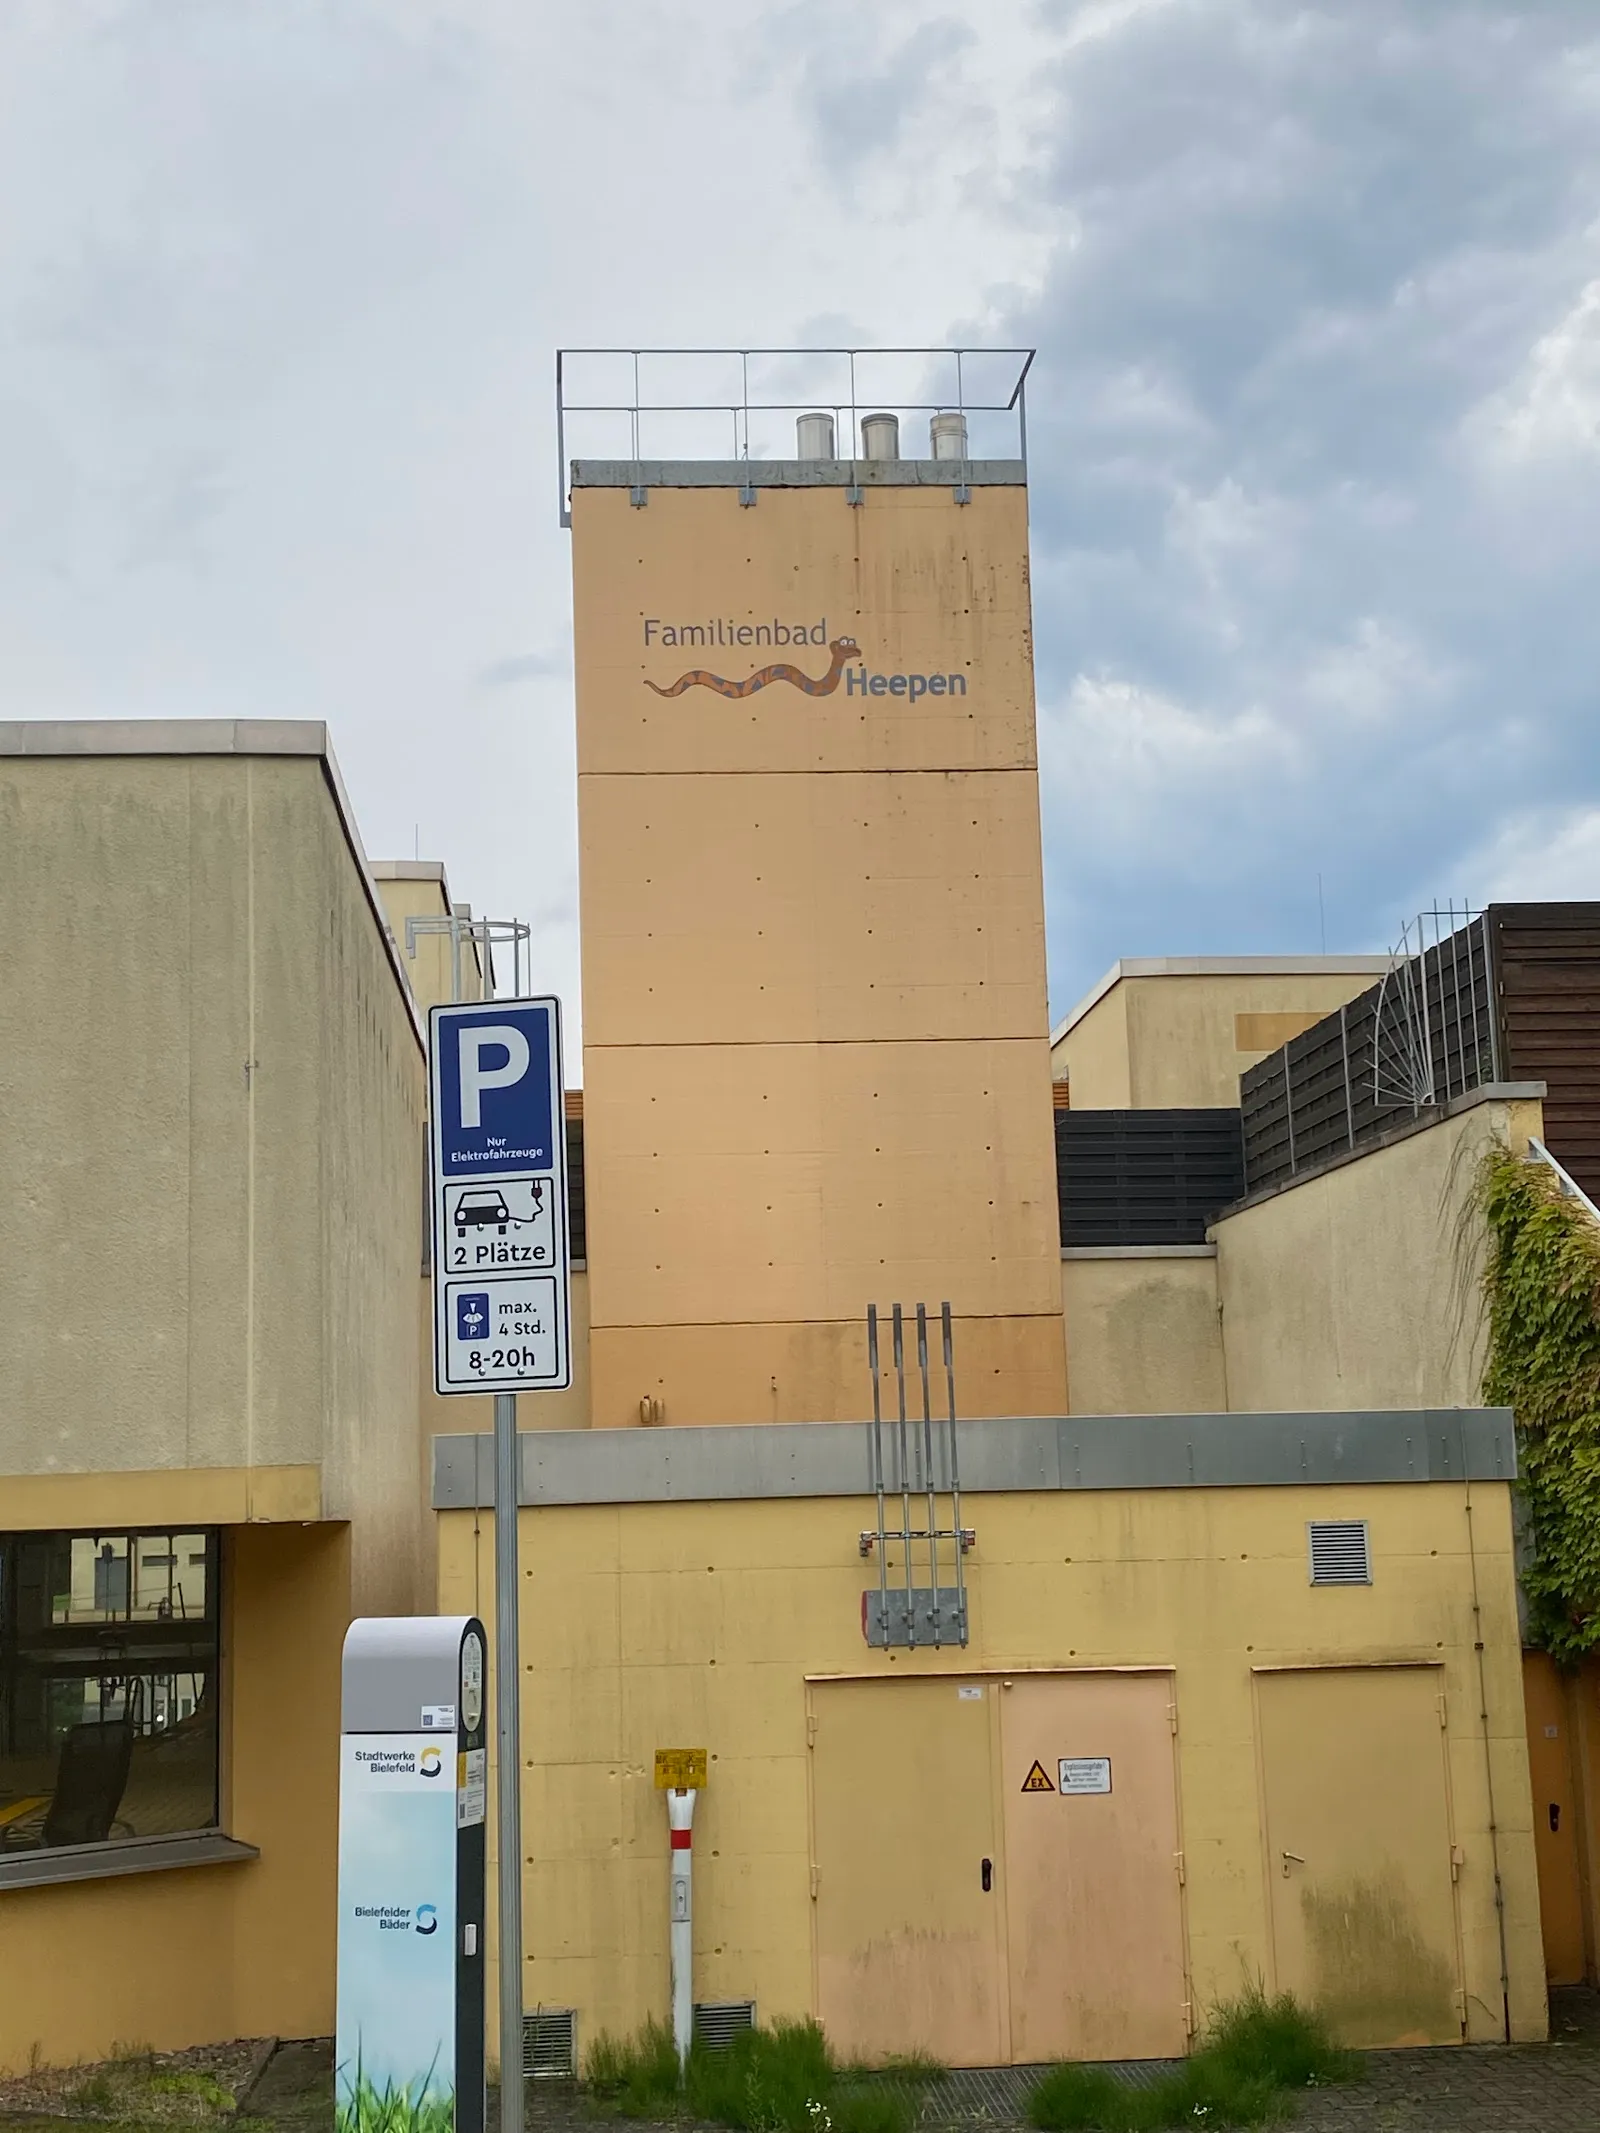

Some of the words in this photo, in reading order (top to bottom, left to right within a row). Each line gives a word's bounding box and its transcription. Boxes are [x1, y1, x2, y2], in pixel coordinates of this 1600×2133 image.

[643, 617, 827, 647] Familienbad
[846, 667, 967, 704] Heepen
[458, 1025, 530, 1129] P
[486, 1137, 507, 1147] Nur
[451, 1147, 543, 1163] Elektrofahrzeuge
[454, 1246, 467, 1265] 2
[476, 1241, 546, 1264] Plätze
[499, 1302, 537, 1314] max.
[469, 1325, 478, 1336] P
[499, 1322, 509, 1336] 4
[513, 1319, 546, 1335] Std.
[469, 1346, 535, 1370] 8-20h
[355, 1750, 416, 1761] Stadtwerke
[370, 1762, 416, 1773] Bielefeld
[1031, 1777, 1045, 1788] EX
[355, 1906, 411, 1918] Bielefelder
[380, 1918, 410, 1930] Bäder
